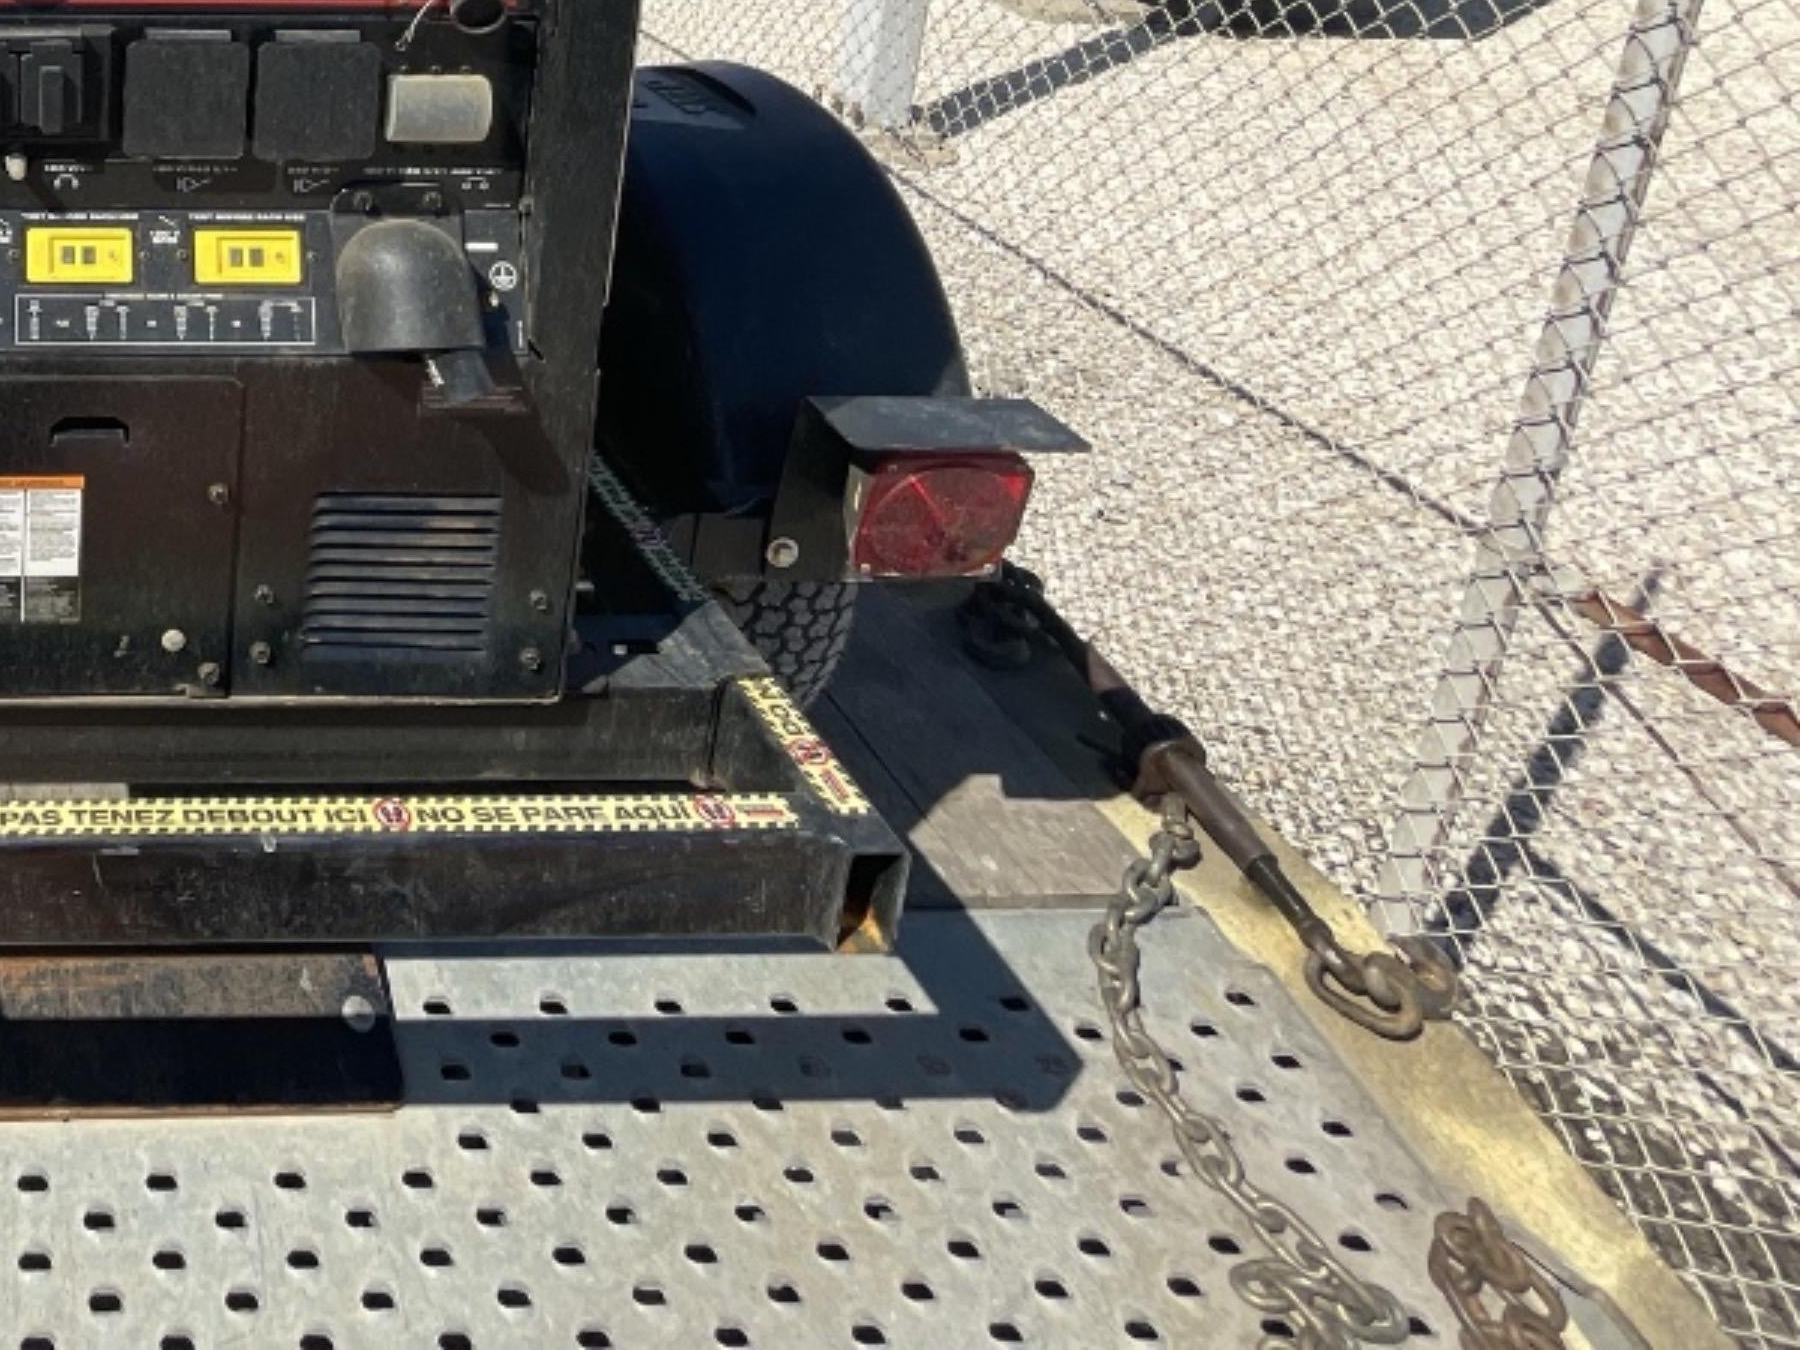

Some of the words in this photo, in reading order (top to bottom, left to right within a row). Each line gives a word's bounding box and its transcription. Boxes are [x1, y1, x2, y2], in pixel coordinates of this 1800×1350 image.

[0, 810, 63, 826] PAS
[68, 810, 175, 825] TENEZ
[182, 808, 317, 824] DEBOUT
[324, 808, 367, 823] ICI
[417, 806, 463, 823] NO
[471, 806, 516, 823] SE
[520, 806, 606, 822] PARE
